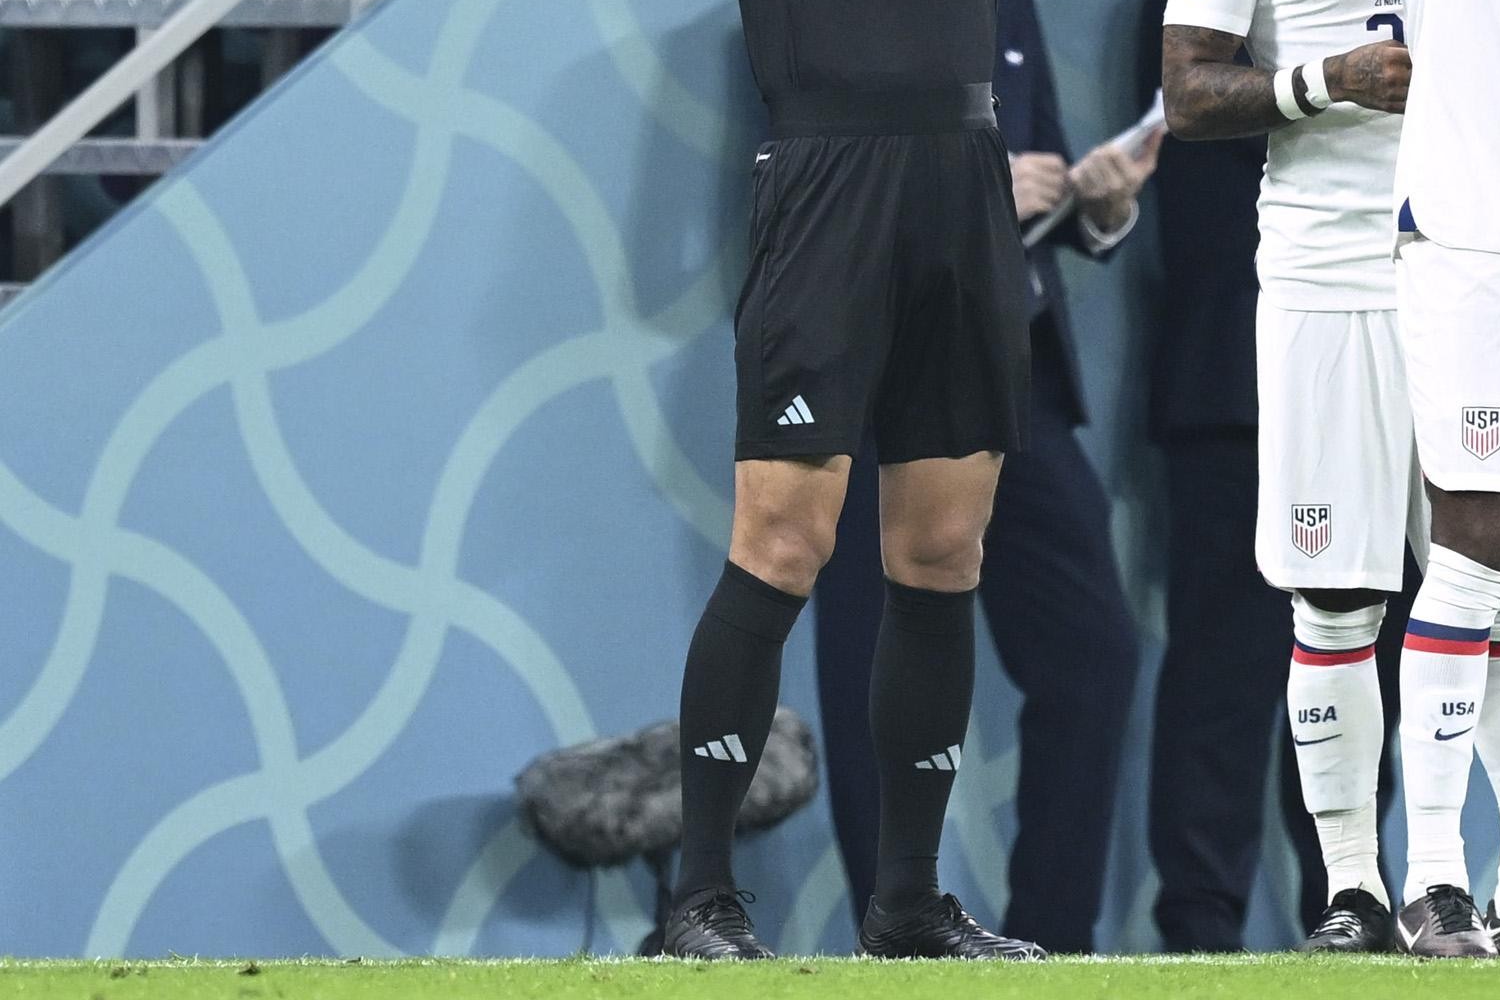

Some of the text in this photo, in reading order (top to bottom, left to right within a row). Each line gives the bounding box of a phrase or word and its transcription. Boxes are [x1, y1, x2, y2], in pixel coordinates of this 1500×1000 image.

[1466, 410, 1499, 430] USA
[1294, 507, 1328, 527] USA
[1298, 705, 1337, 724] USA
[1441, 701, 1475, 716] USA
